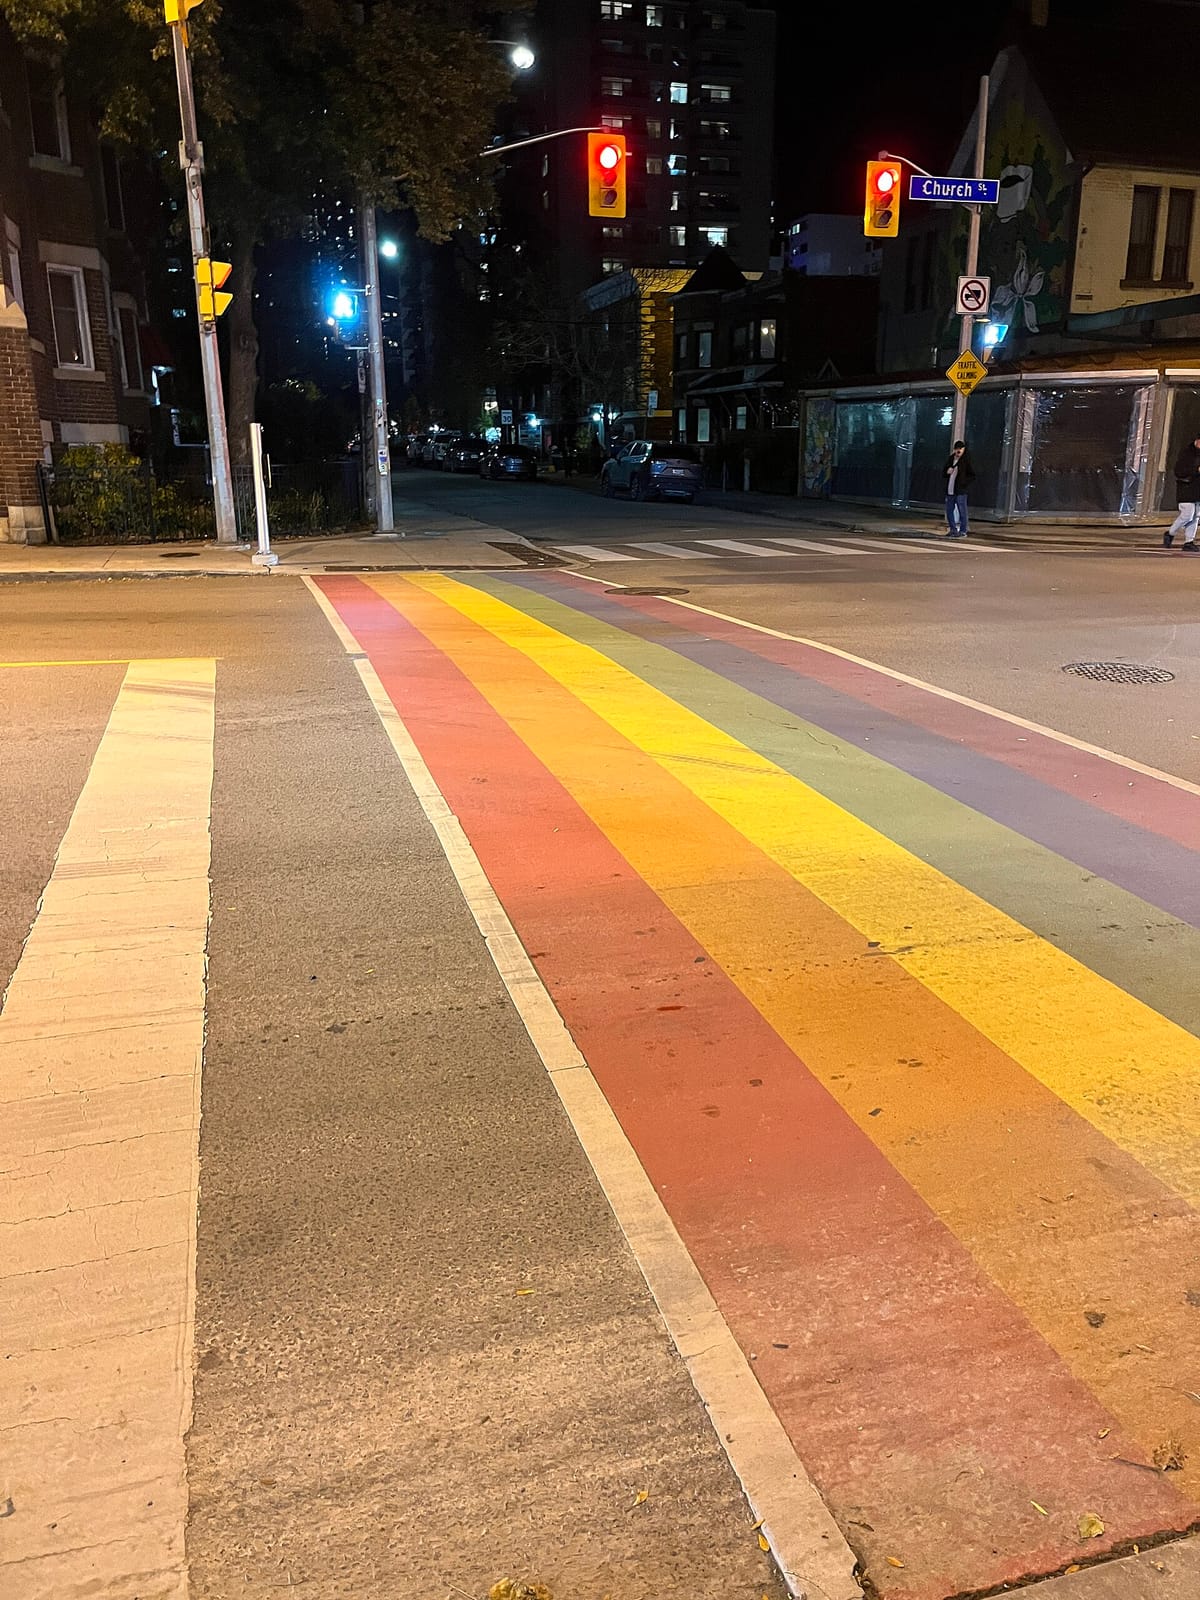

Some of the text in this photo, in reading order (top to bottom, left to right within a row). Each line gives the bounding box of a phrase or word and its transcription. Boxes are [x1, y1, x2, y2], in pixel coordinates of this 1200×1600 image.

[922, 180, 972, 197] Church
[958, 361, 977, 369] TRAFFIC
[957, 372, 977, 380] CALMING
[503, 415, 512, 423] 30
